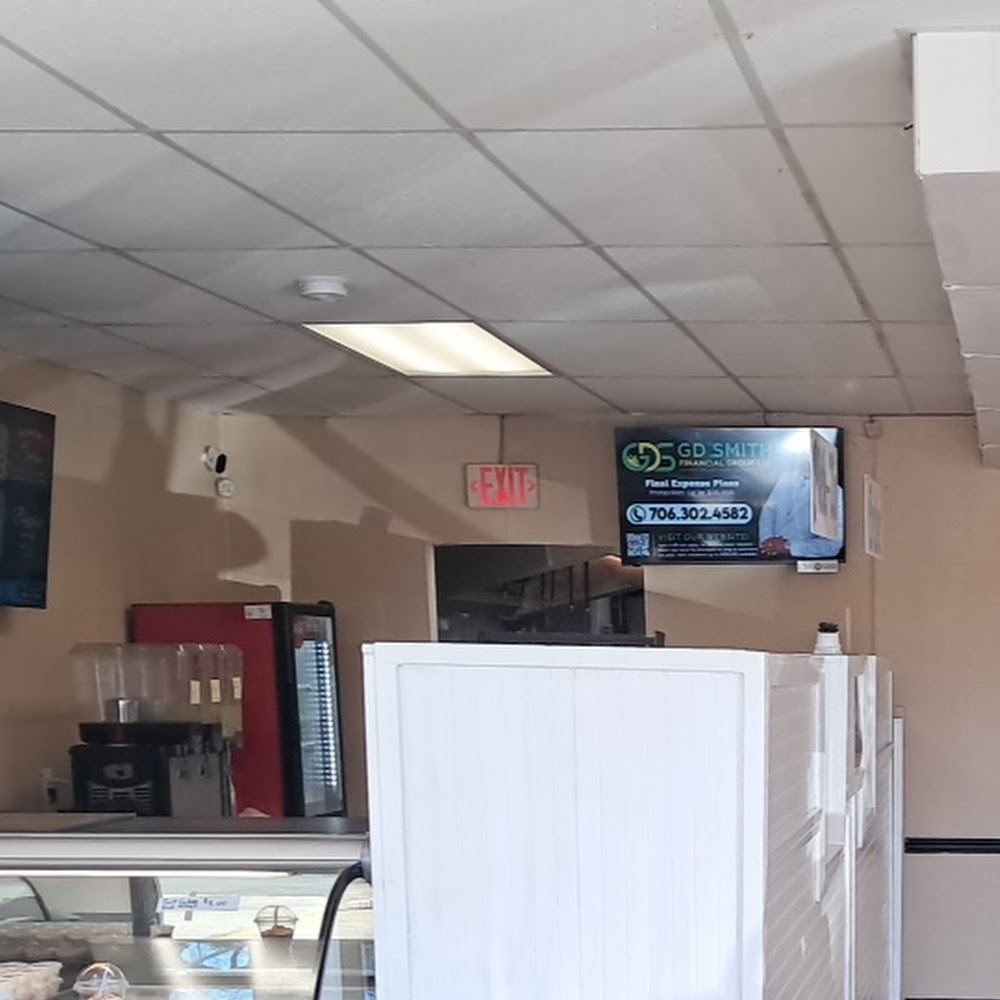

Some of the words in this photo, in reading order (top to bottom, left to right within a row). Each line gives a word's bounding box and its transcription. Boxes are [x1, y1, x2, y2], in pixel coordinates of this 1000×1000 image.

[678, 443, 706, 457] GD
[713, 443, 773, 457] SMITH
[481, 467, 527, 504] EXIT
[645, 479, 669, 487] Final
[671, 479, 711, 489] Expense
[649, 506, 749, 521] 706.302.4582
